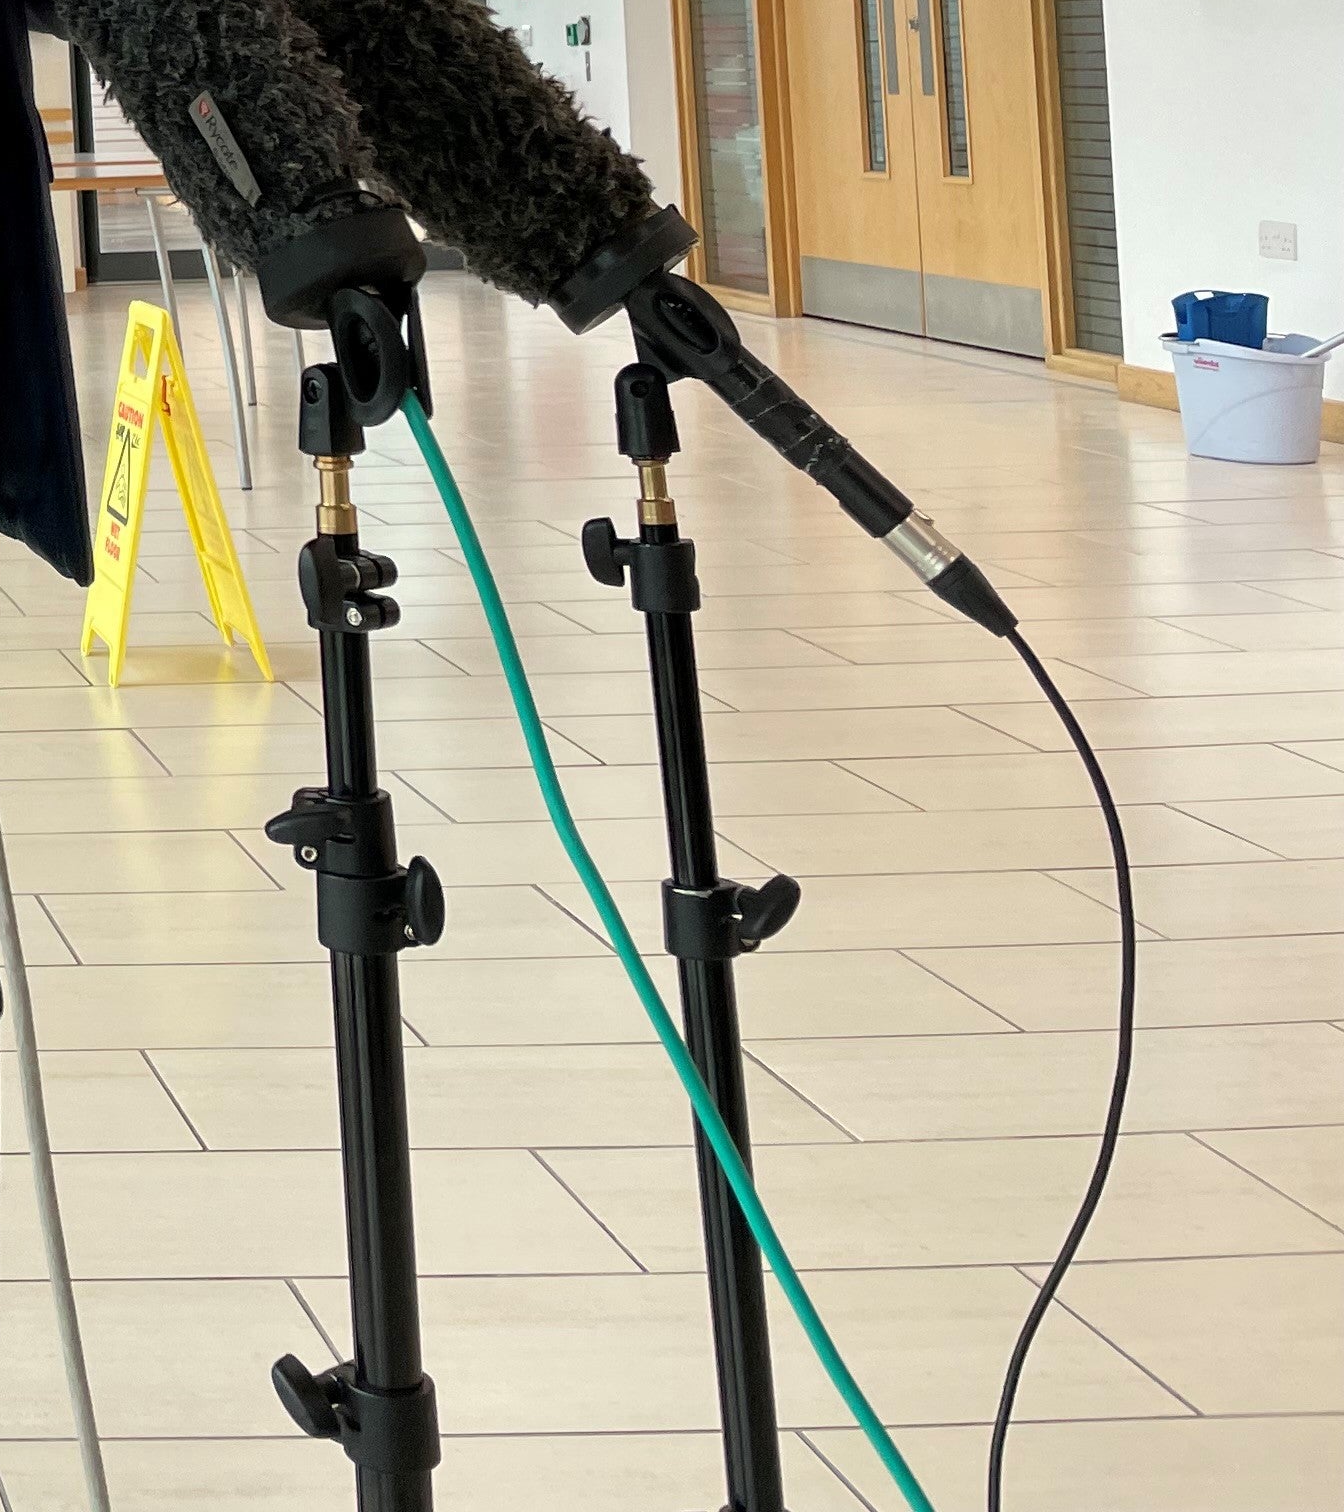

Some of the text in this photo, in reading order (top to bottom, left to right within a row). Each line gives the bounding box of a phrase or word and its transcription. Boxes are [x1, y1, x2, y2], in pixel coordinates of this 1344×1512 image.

[206, 116, 238, 170] Rycote
[118, 401, 144, 429] CAUTION
[105, 537, 120, 561] FLOOR
